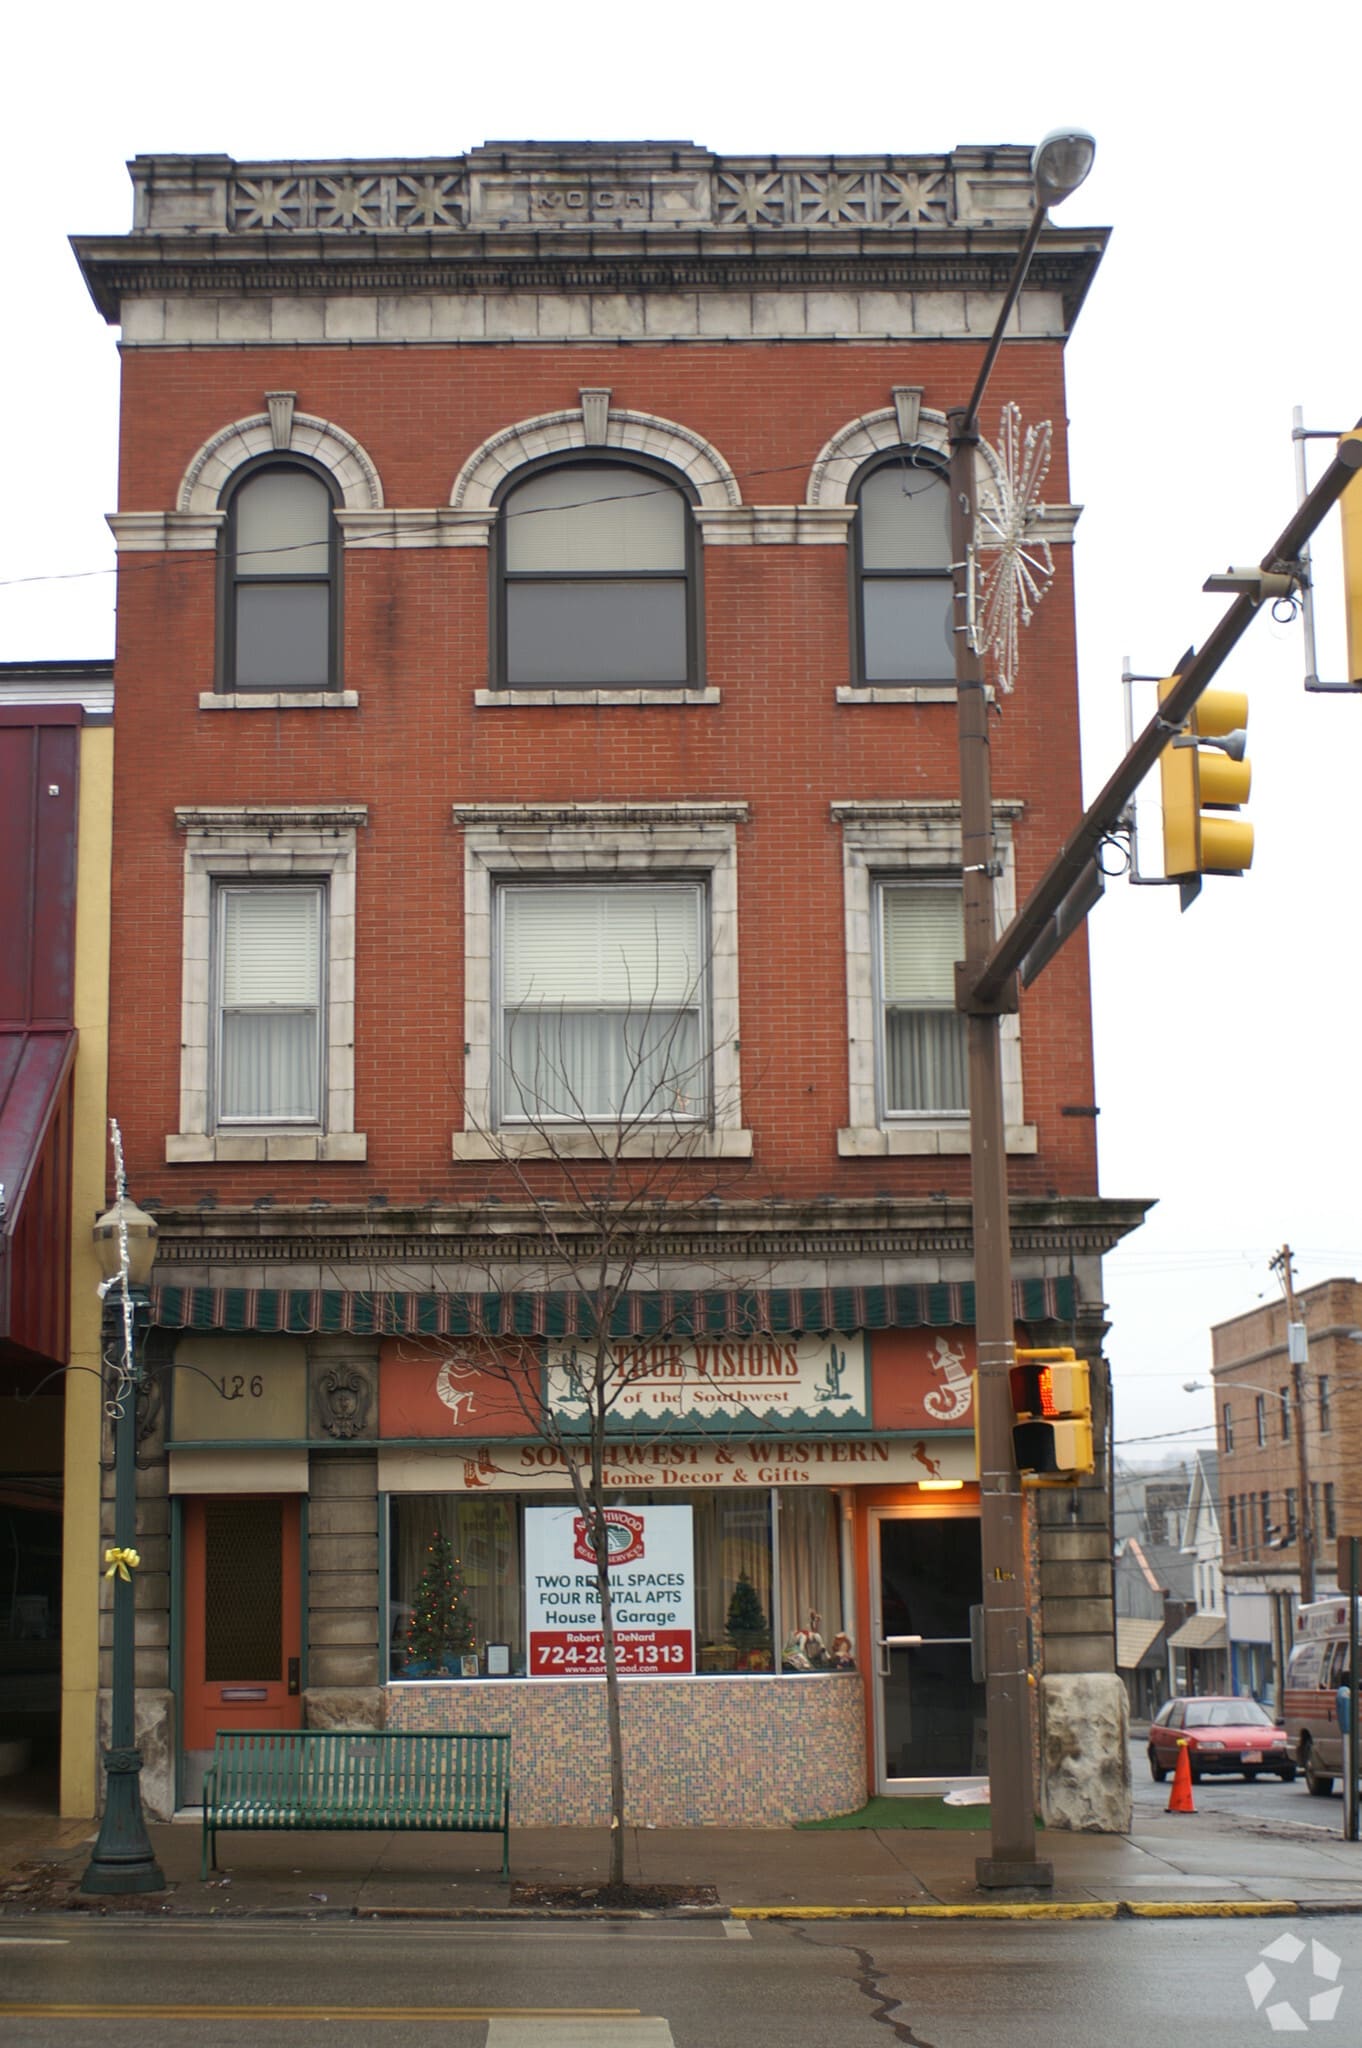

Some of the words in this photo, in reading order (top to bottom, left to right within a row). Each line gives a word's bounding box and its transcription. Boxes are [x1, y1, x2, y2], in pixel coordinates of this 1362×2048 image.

[538, 190, 645, 208] KOCH
[613, 1343, 685, 1379] TRUE
[697, 1341, 800, 1378] VISIONS
[221, 1375, 263, 1399] 126
[623, 1391, 644, 1404] of
[652, 1391, 681, 1403] the
[693, 1390, 789, 1403] Southwest
[520, 1443, 704, 1466] SOUTHWEST
[714, 1444, 735, 1465] &
[746, 1440, 890, 1463] WESTERN
[661, 1469, 724, 1485] Decor
[732, 1468, 748, 1483] &
[757, 1466, 810, 1482] Gifts
[575, 1511, 642, 1532] NHWOOD
[536, 1575, 571, 1588] TWO
[627, 1573, 685, 1587] SPACES
[540, 1592, 581, 1605] FOUR
[585, 1591, 641, 1604] RETAL
[645, 1590, 682, 1603] APTS
[545, 1610, 596, 1624] House
[616, 1609, 676, 1626] Garage
[566, 1633, 600, 1643] Robert
[616, 1632, 656, 1642] DeNard
[537, 1645, 684, 1664] 724-282-1313
[564, 1664, 658, 1673] www.nortwood.com
